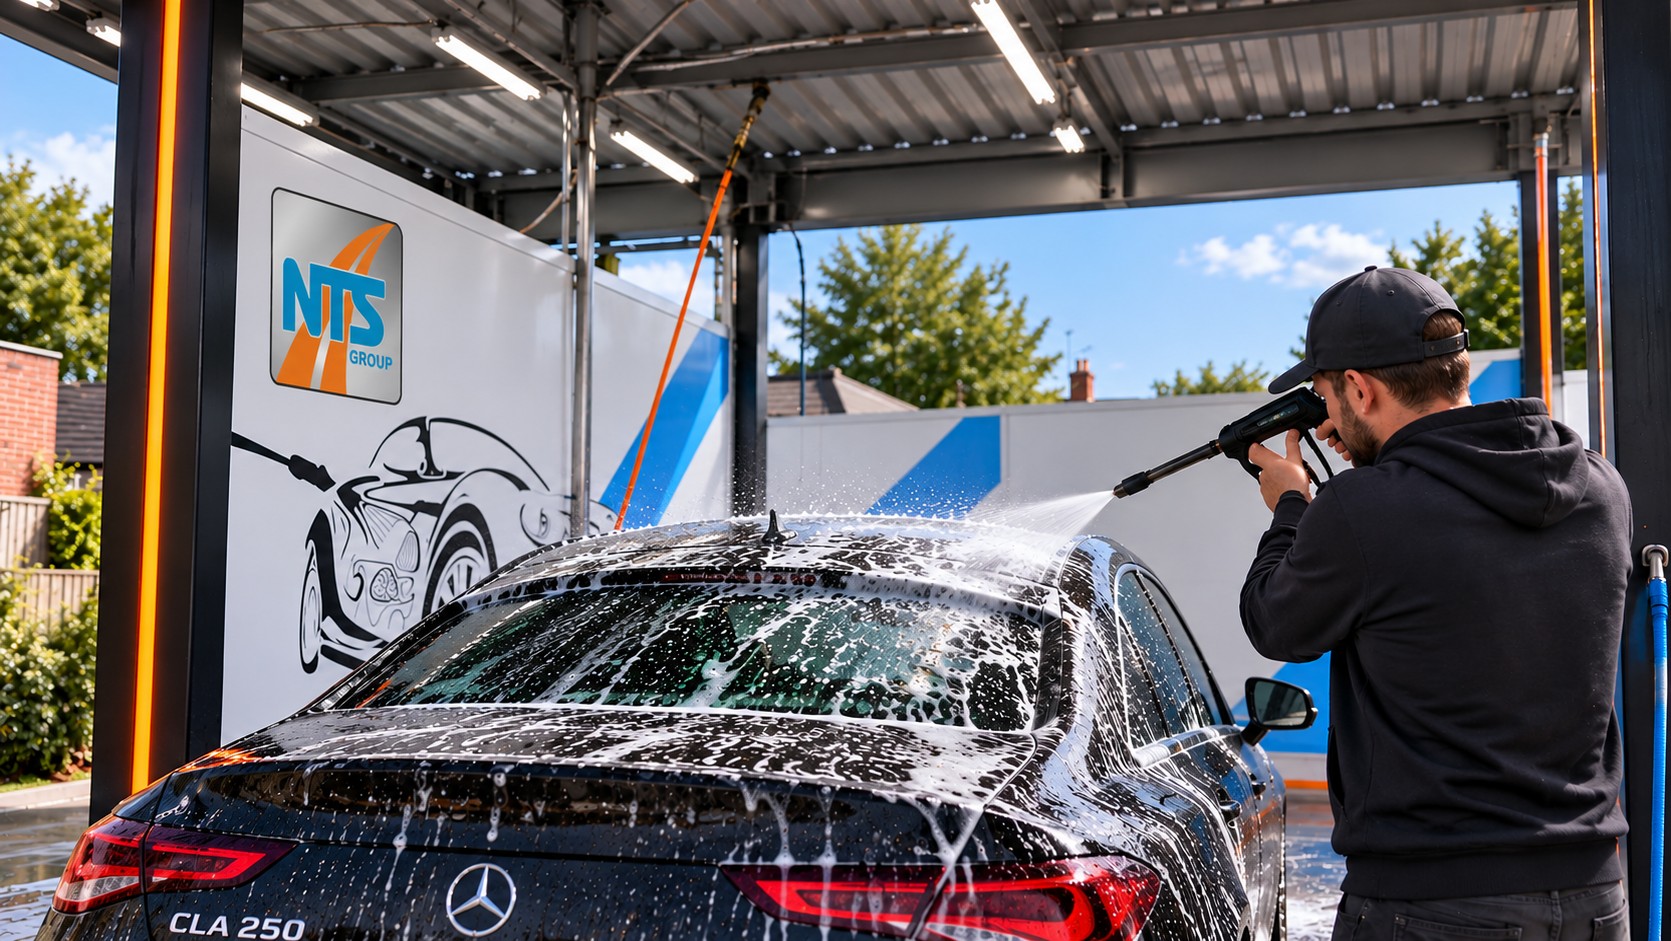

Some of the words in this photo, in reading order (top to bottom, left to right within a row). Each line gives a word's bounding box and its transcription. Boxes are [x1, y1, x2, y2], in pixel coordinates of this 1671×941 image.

[282, 257, 386, 347] NTS
[349, 349, 393, 370] GROUP
[169, 912, 229, 937] CLA
[237, 916, 306, 941] 250
